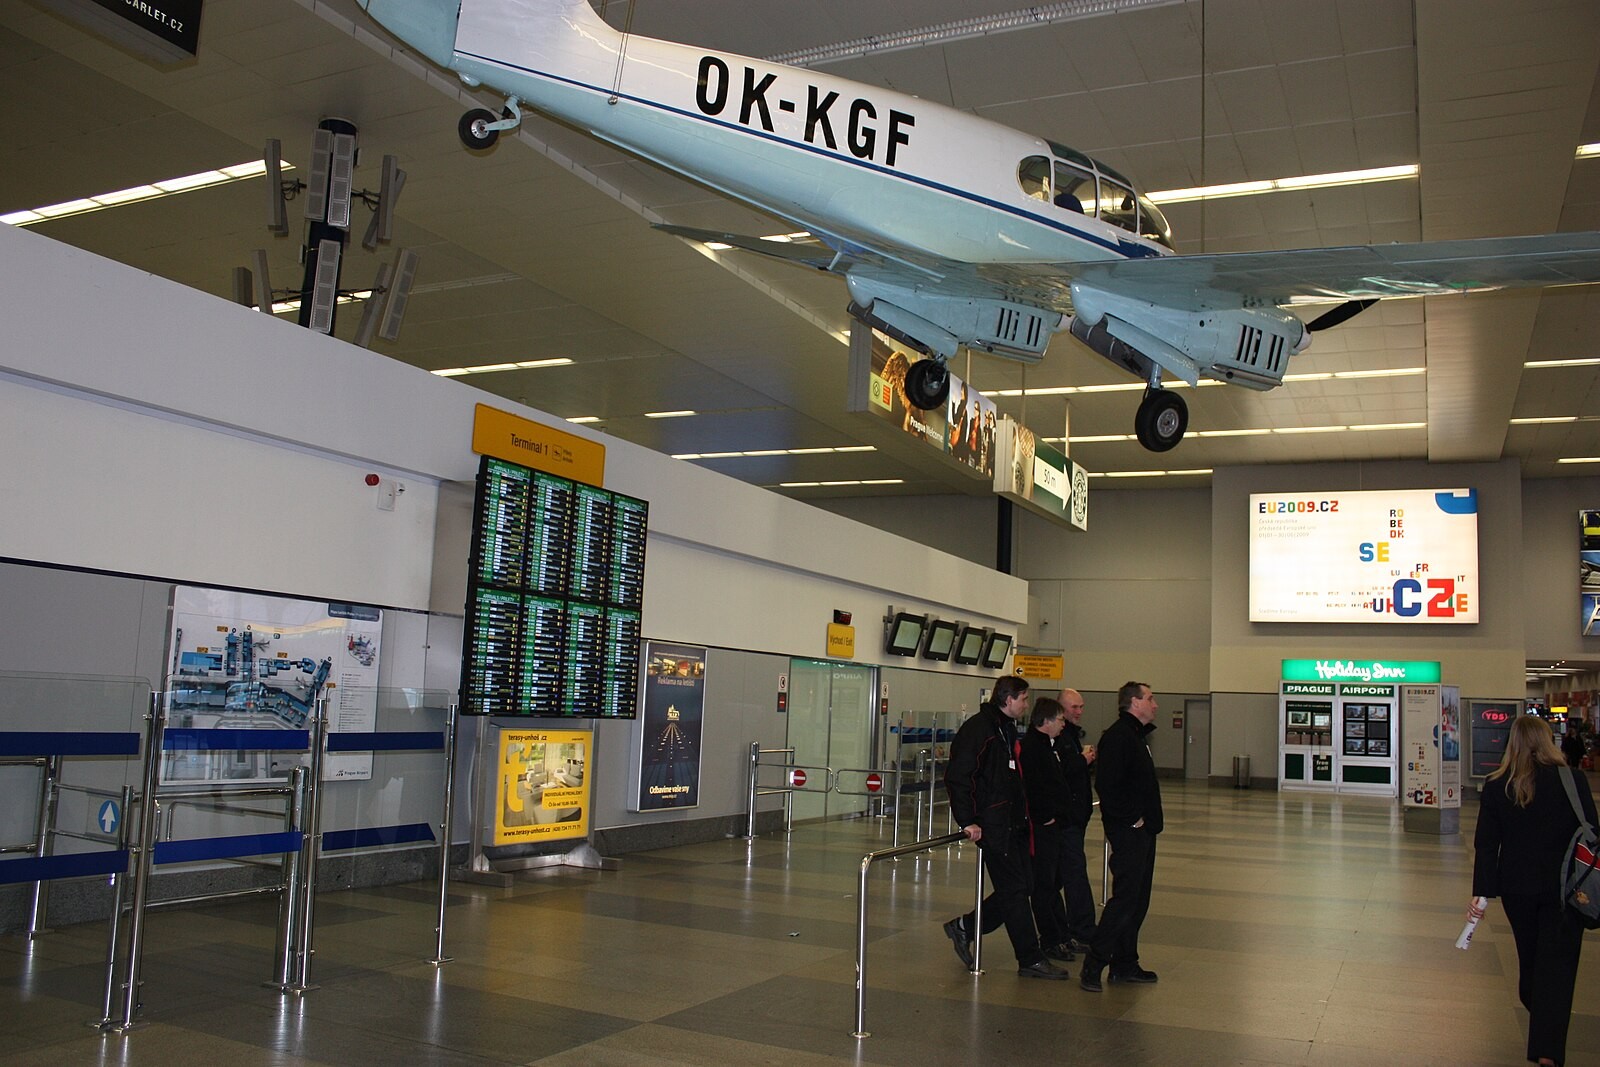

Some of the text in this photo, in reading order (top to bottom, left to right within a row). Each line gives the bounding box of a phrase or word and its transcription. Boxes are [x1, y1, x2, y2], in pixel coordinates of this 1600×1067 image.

[695, 55, 916, 167] OK-KGF
[510, 433, 549, 456] Terminal 1
[1258, 500, 1339, 514] EU2009.CZ
[1389, 509, 1404, 517] RO
[1389, 519, 1403, 528] BE
[1389, 530, 1404, 538] DK
[1359, 541, 1390, 562] SE
[1416, 563, 1429, 572] FR
[1392, 578, 1455, 617] CZ
[1315, 660, 1405, 681] Holiday Inn
[1287, 685, 1391, 695] PRAGUE AIRPORT
